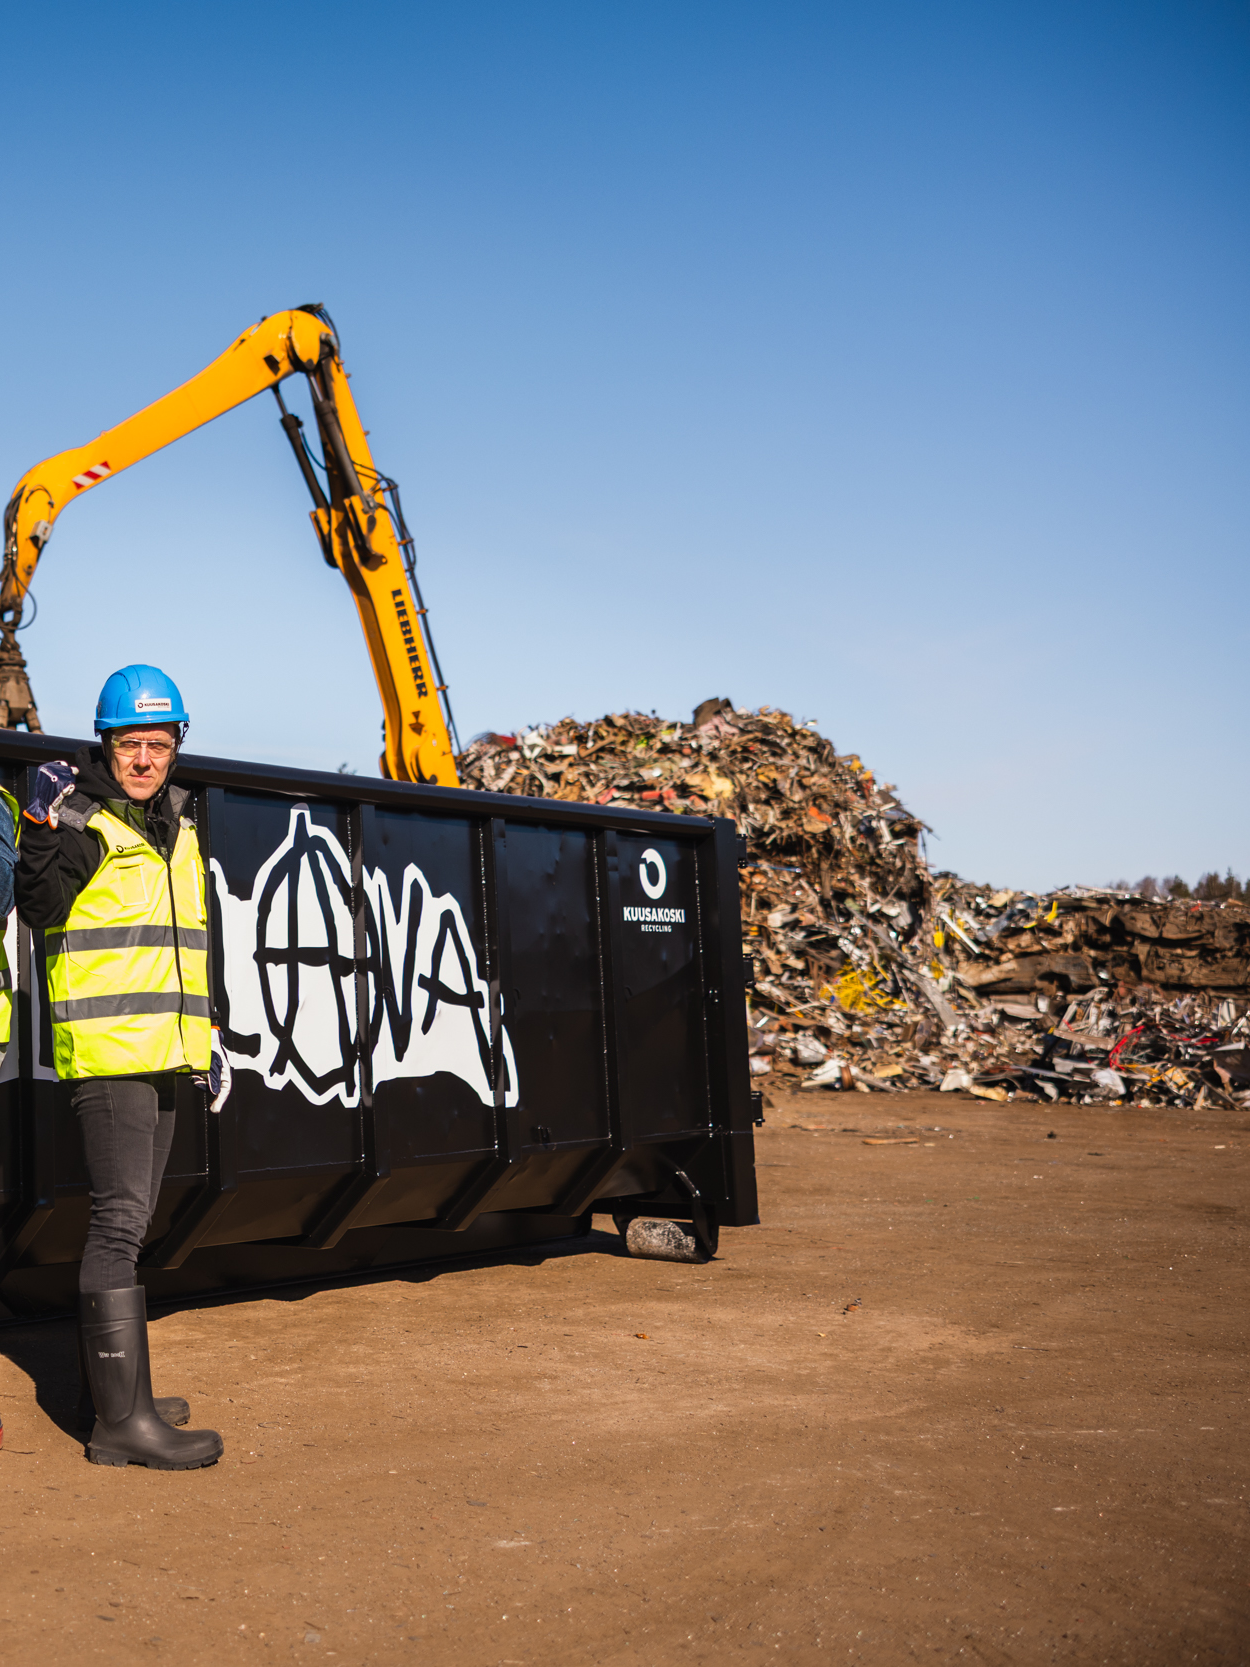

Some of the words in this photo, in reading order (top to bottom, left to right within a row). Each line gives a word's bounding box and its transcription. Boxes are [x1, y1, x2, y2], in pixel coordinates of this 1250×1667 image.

[390, 588, 428, 699] LIEBHERR
[623, 906, 686, 923] KUUSAKOSKI
[640, 924, 672, 933] RECYCLING
